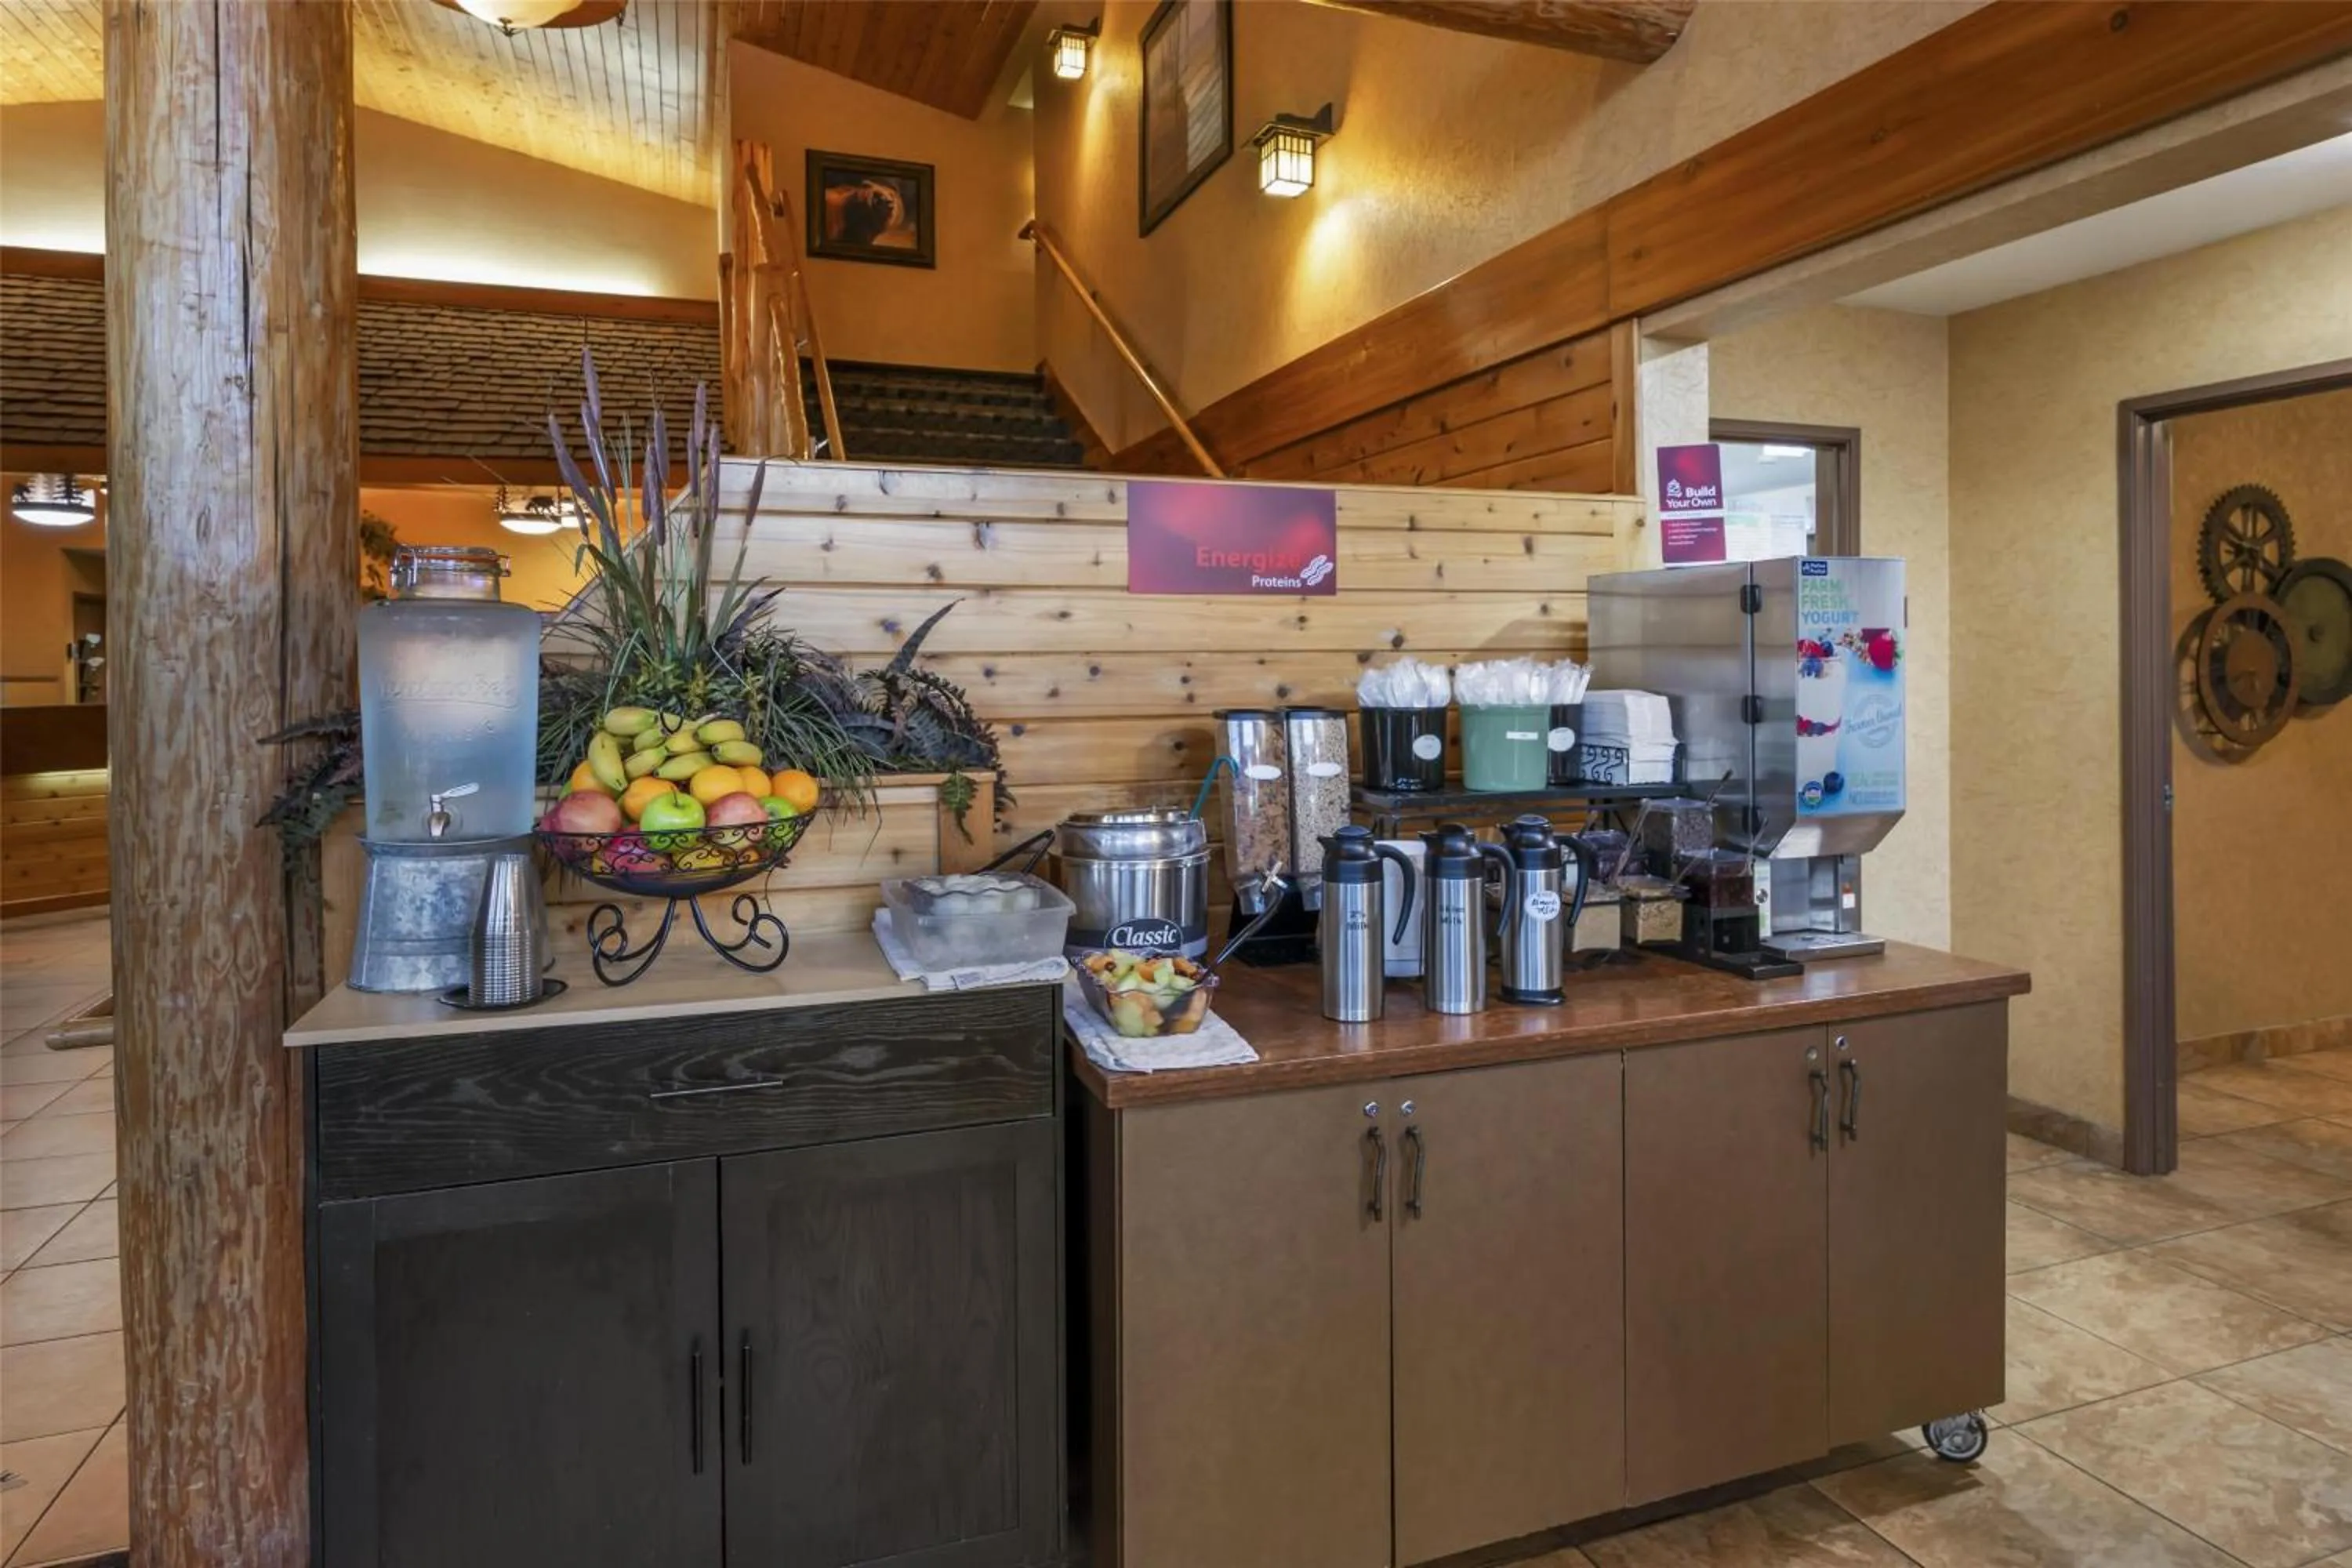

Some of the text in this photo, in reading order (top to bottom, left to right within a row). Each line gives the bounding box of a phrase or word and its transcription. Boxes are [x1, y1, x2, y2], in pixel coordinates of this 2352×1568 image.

[1686, 485, 1716, 498] Build
[1666, 499, 1690, 509] Your
[1691, 497, 1717, 507] Own
[1252, 575, 1301, 588] Proteins
[1802, 611, 1860, 625] YOGURT
[1111, 924, 1178, 947] Classic
